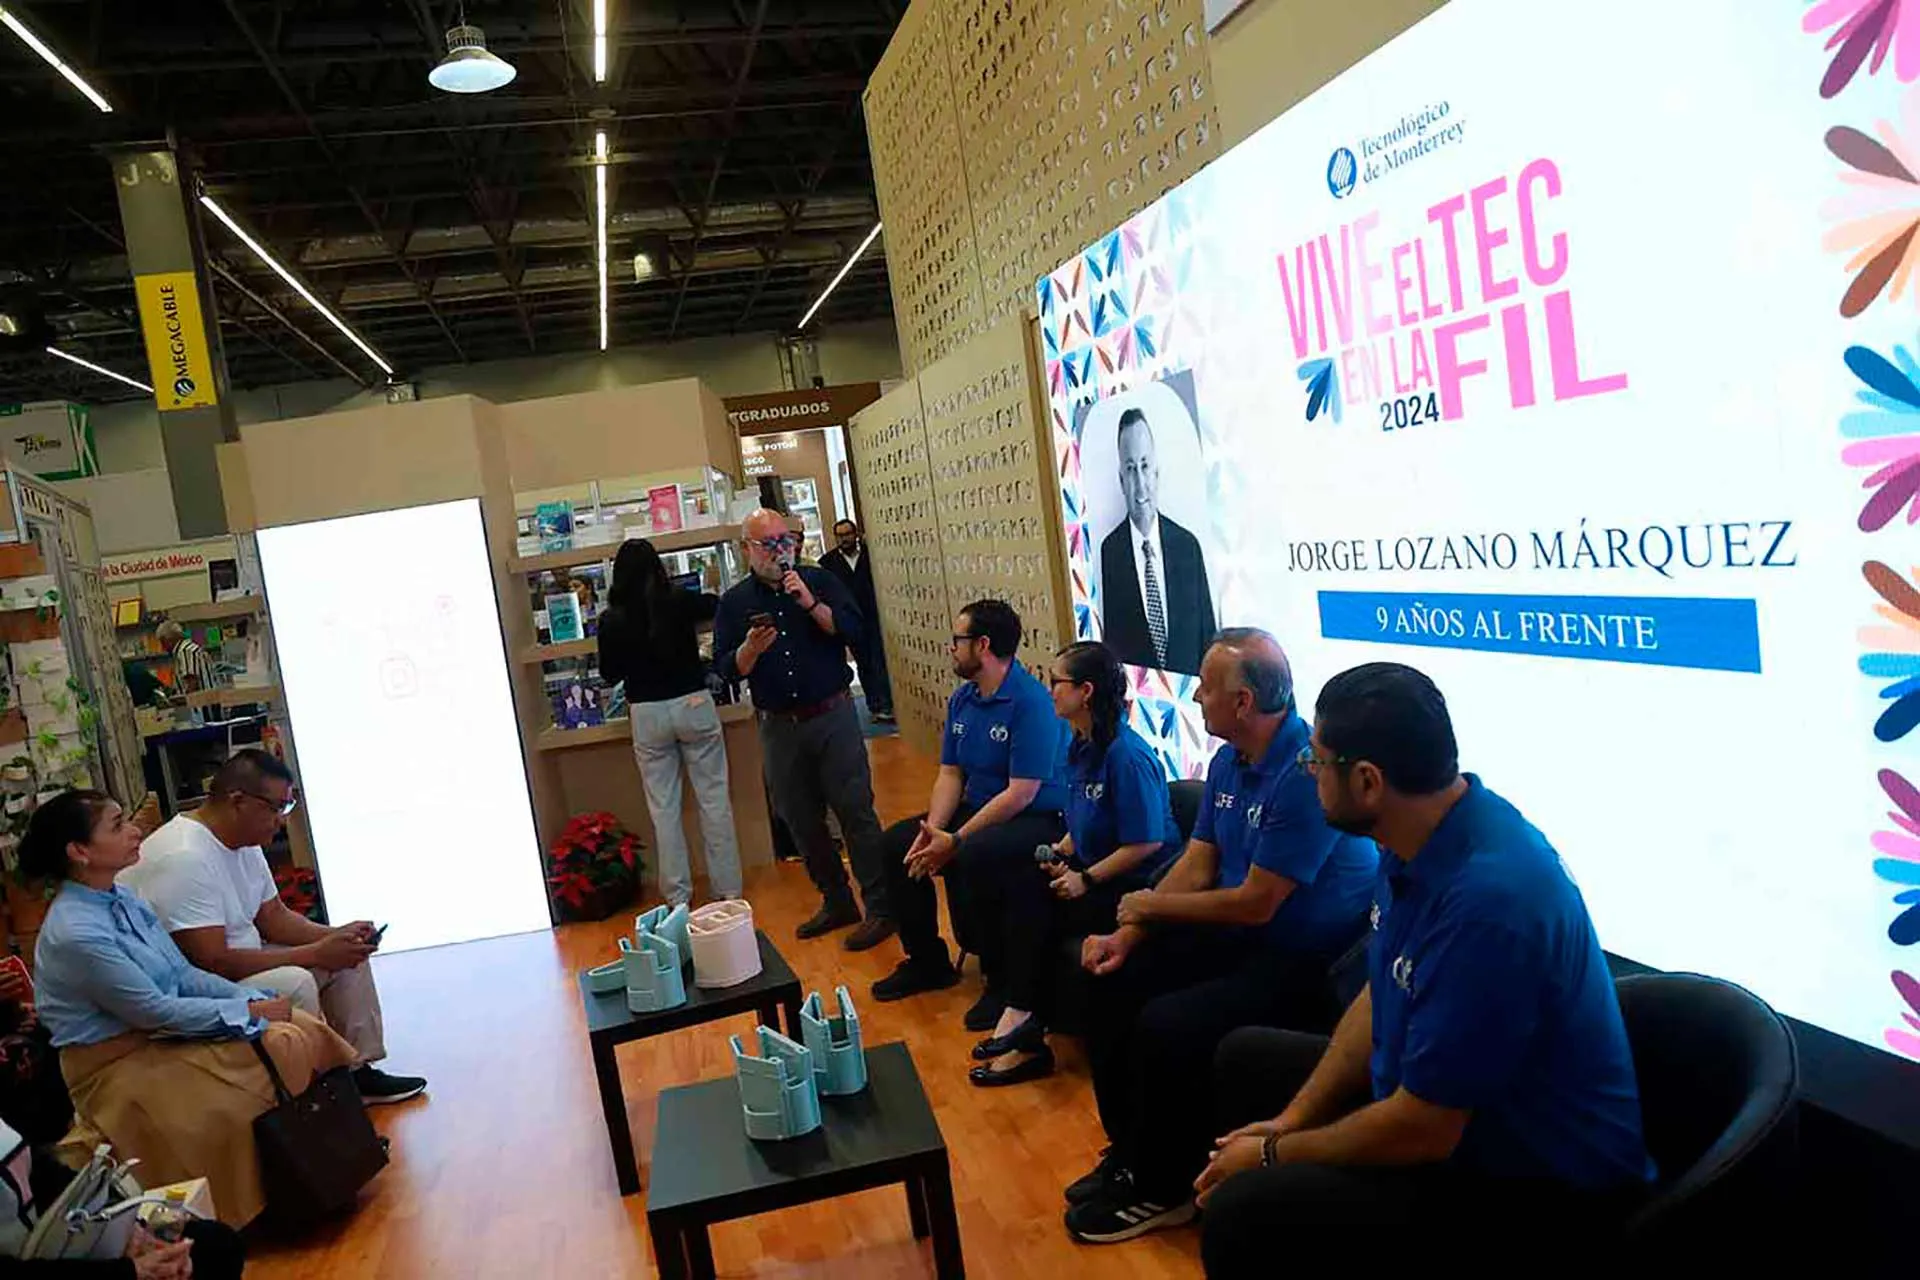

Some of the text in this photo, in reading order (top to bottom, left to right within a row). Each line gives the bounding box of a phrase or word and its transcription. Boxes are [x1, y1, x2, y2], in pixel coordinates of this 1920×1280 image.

[1359, 101, 1450, 159] Tecnológico
[1363, 119, 1466, 183] de Monterrey
[1276, 157, 1570, 359] VIVE EL TEC
[161, 283, 189, 377] MEGACABLE
[1340, 290, 1629, 421] EN LA FIL
[1380, 391, 1440, 432] 2024
[1287, 517, 1798, 579] JORGE LOZANO MÁRQUEZ
[1376, 601, 1659, 651] 9 AÑOS AL FRENTE
